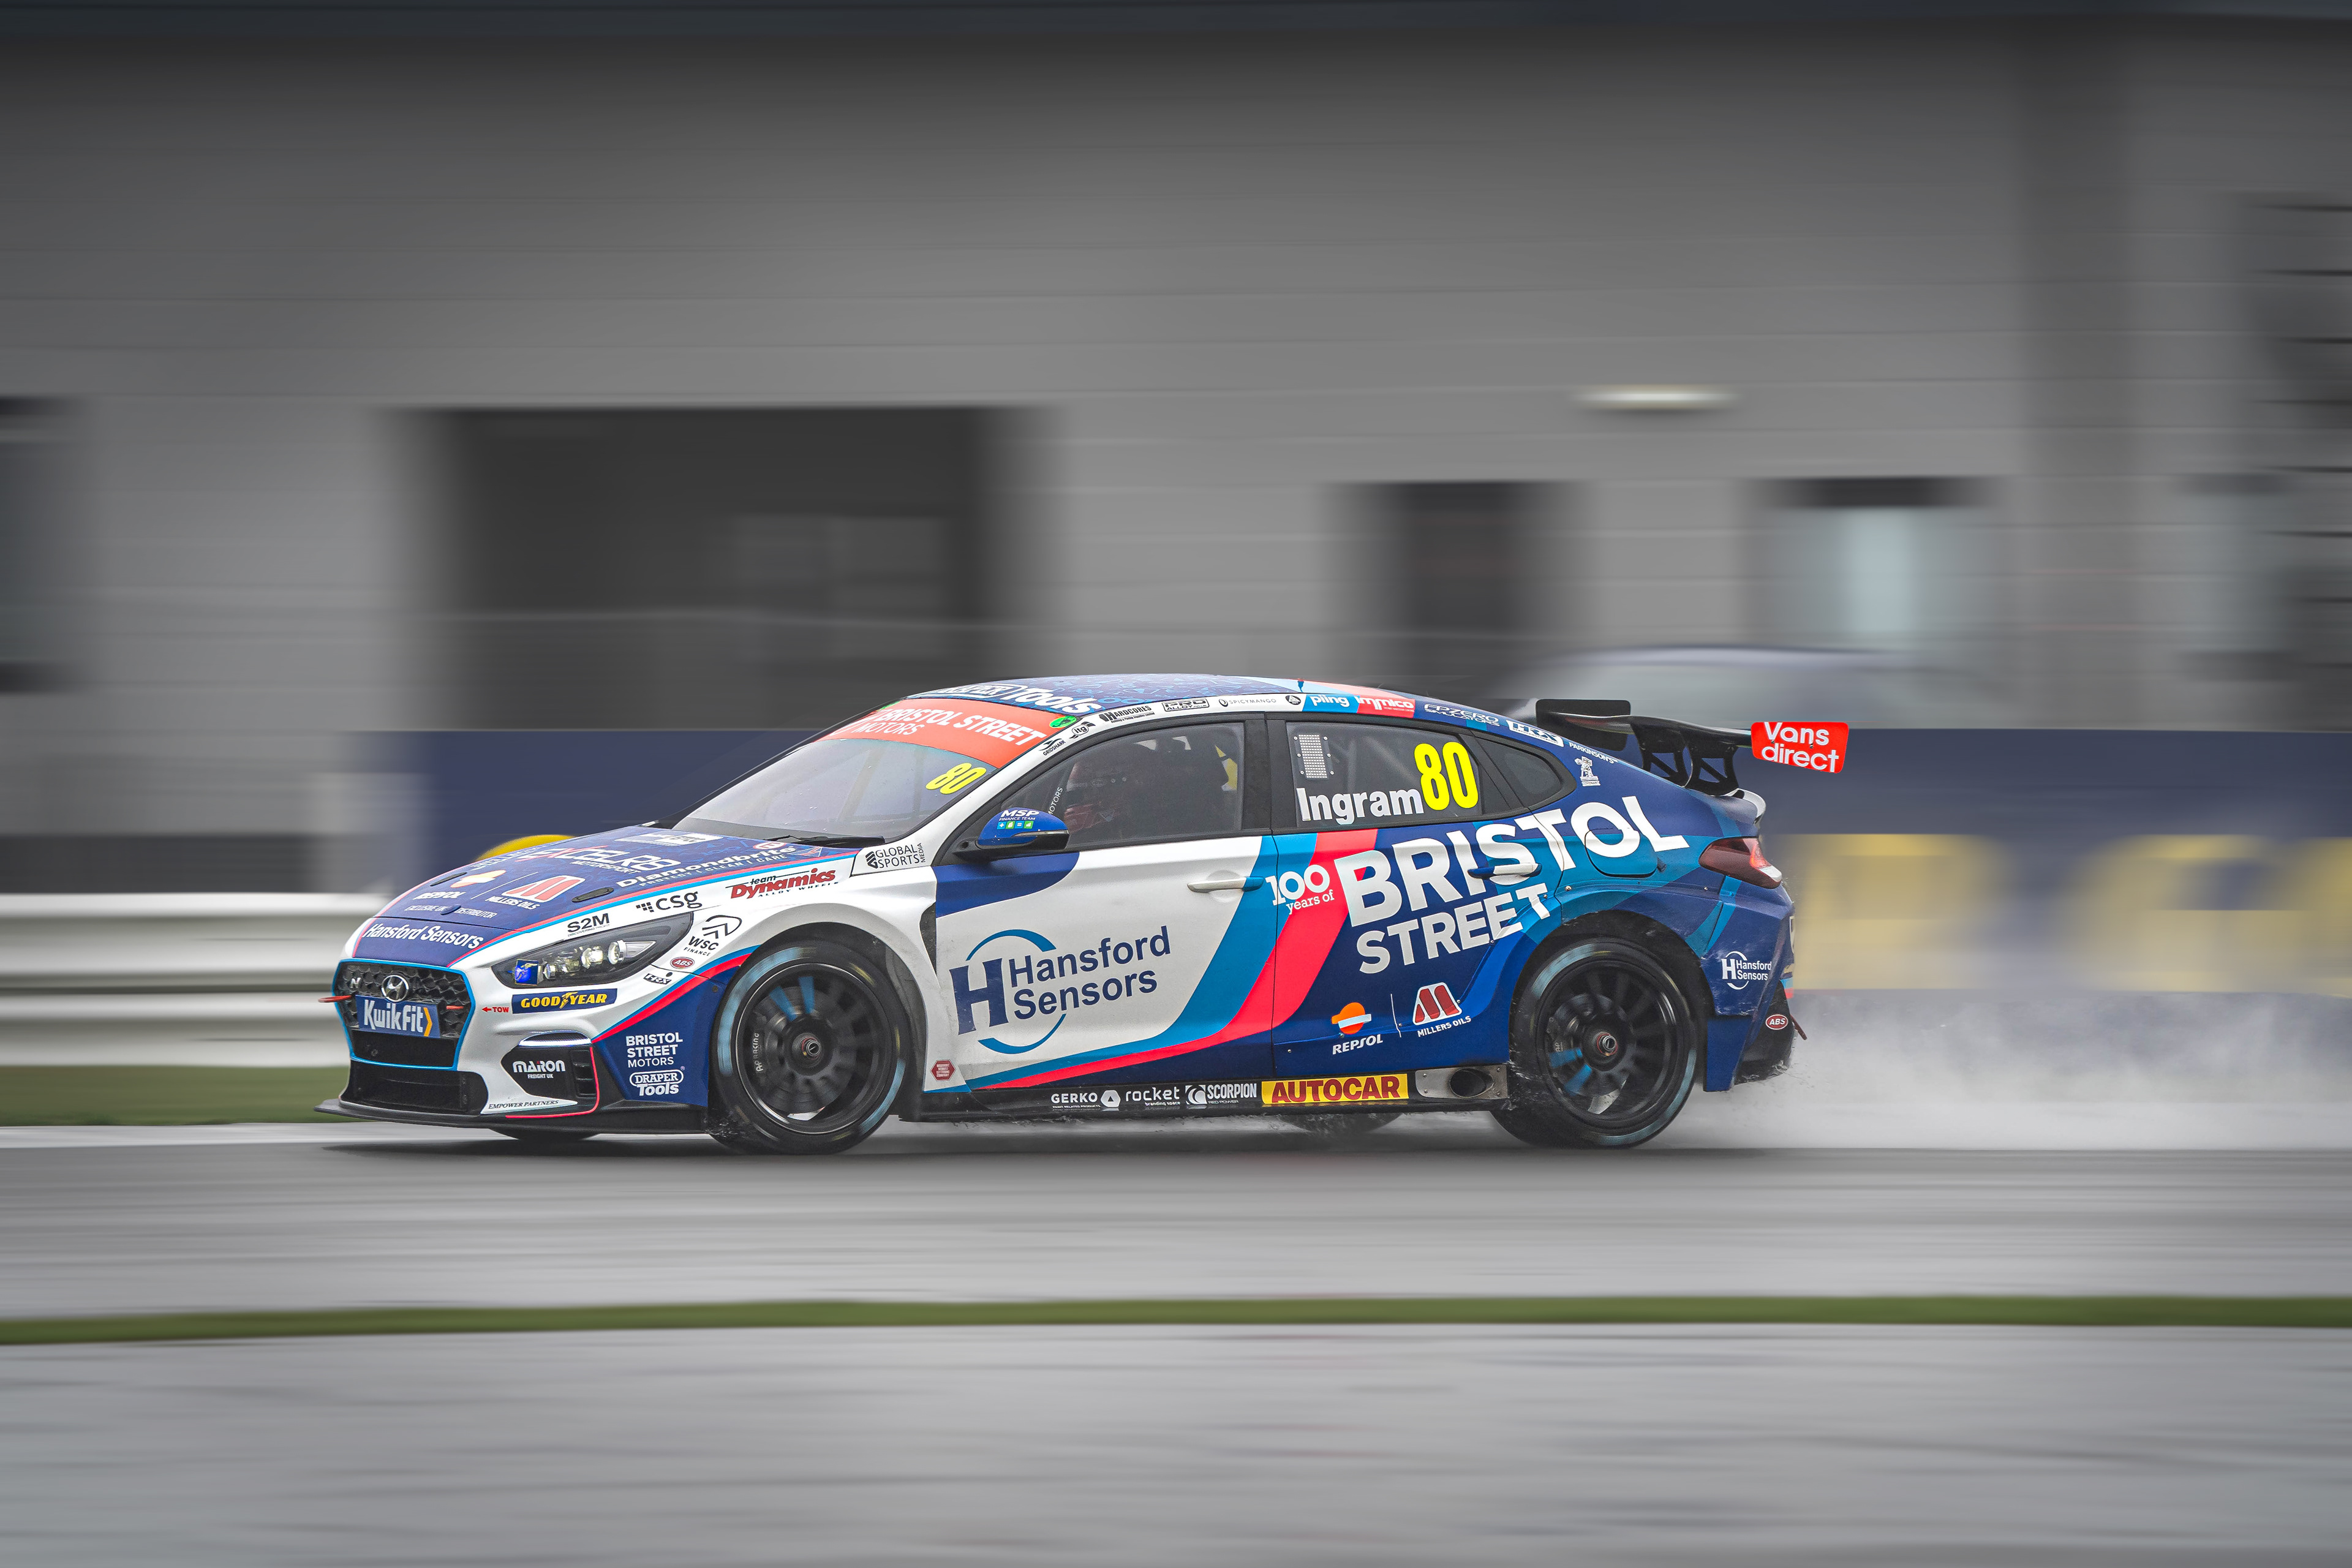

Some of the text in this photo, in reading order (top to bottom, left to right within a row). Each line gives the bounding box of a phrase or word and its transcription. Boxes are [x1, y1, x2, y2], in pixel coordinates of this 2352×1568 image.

[1000, 688, 1101, 713] Tools
[1310, 695, 1350, 707] piing
[1104, 706, 1152, 721] HARDCORES
[851, 722, 925, 735] MOTORS
[873, 709, 1047, 746] BRISTOL STREET
[1764, 722, 1830, 745] Vans
[1043, 740, 1066, 756] GRIDSHARK
[1762, 743, 1839, 772] direct
[926, 763, 986, 794] 80
[1414, 741, 1479, 811] 80
[1000, 809, 1039, 818] MSP
[1296, 787, 1425, 825] Ingram
[875, 844, 918, 858] GLOBAL
[917, 843, 925, 862] MEDIA
[570, 861, 641, 874] MOTORSPORT
[616, 848, 796, 888] Diamondbrite
[878, 854, 919, 869] SPORTS
[1334, 796, 1689, 927] BRISTOL
[731, 868, 836, 899] Dynamics
[750, 875, 777, 885] team
[1265, 864, 1330, 906] 100
[485, 896, 540, 910] MILLERS OILS
[656, 891, 703, 910] csg
[1286, 889, 1335, 914] years of
[567, 913, 609, 932] S2M
[1356, 882, 1550, 974] STREET
[362, 923, 484, 949] Hansford Sensors
[688, 936, 718, 950] WSC
[684, 947, 710, 956] FINANCE
[1009, 925, 1171, 987] Hansford
[1736, 960, 1772, 971] Hansford
[1737, 970, 1769, 981] Sensors
[1014, 970, 1158, 1020] Sensors
[1417, 1016, 1471, 1038] MILLERS OILS
[626, 1032, 683, 1046] BRISTOL
[1332, 1034, 1383, 1055] REPSOL
[627, 1044, 678, 1058] STREET
[628, 1057, 674, 1068] MOTORS
[635, 1072, 679, 1084] DRAPER
[636, 1082, 679, 1096] Tools
[1050, 1092, 1098, 1103] GERKO
[1125, 1087, 1180, 1101] rocket
[1207, 1084, 1257, 1099] SCORPION
[1272, 1076, 1400, 1103] AUTOCAR
